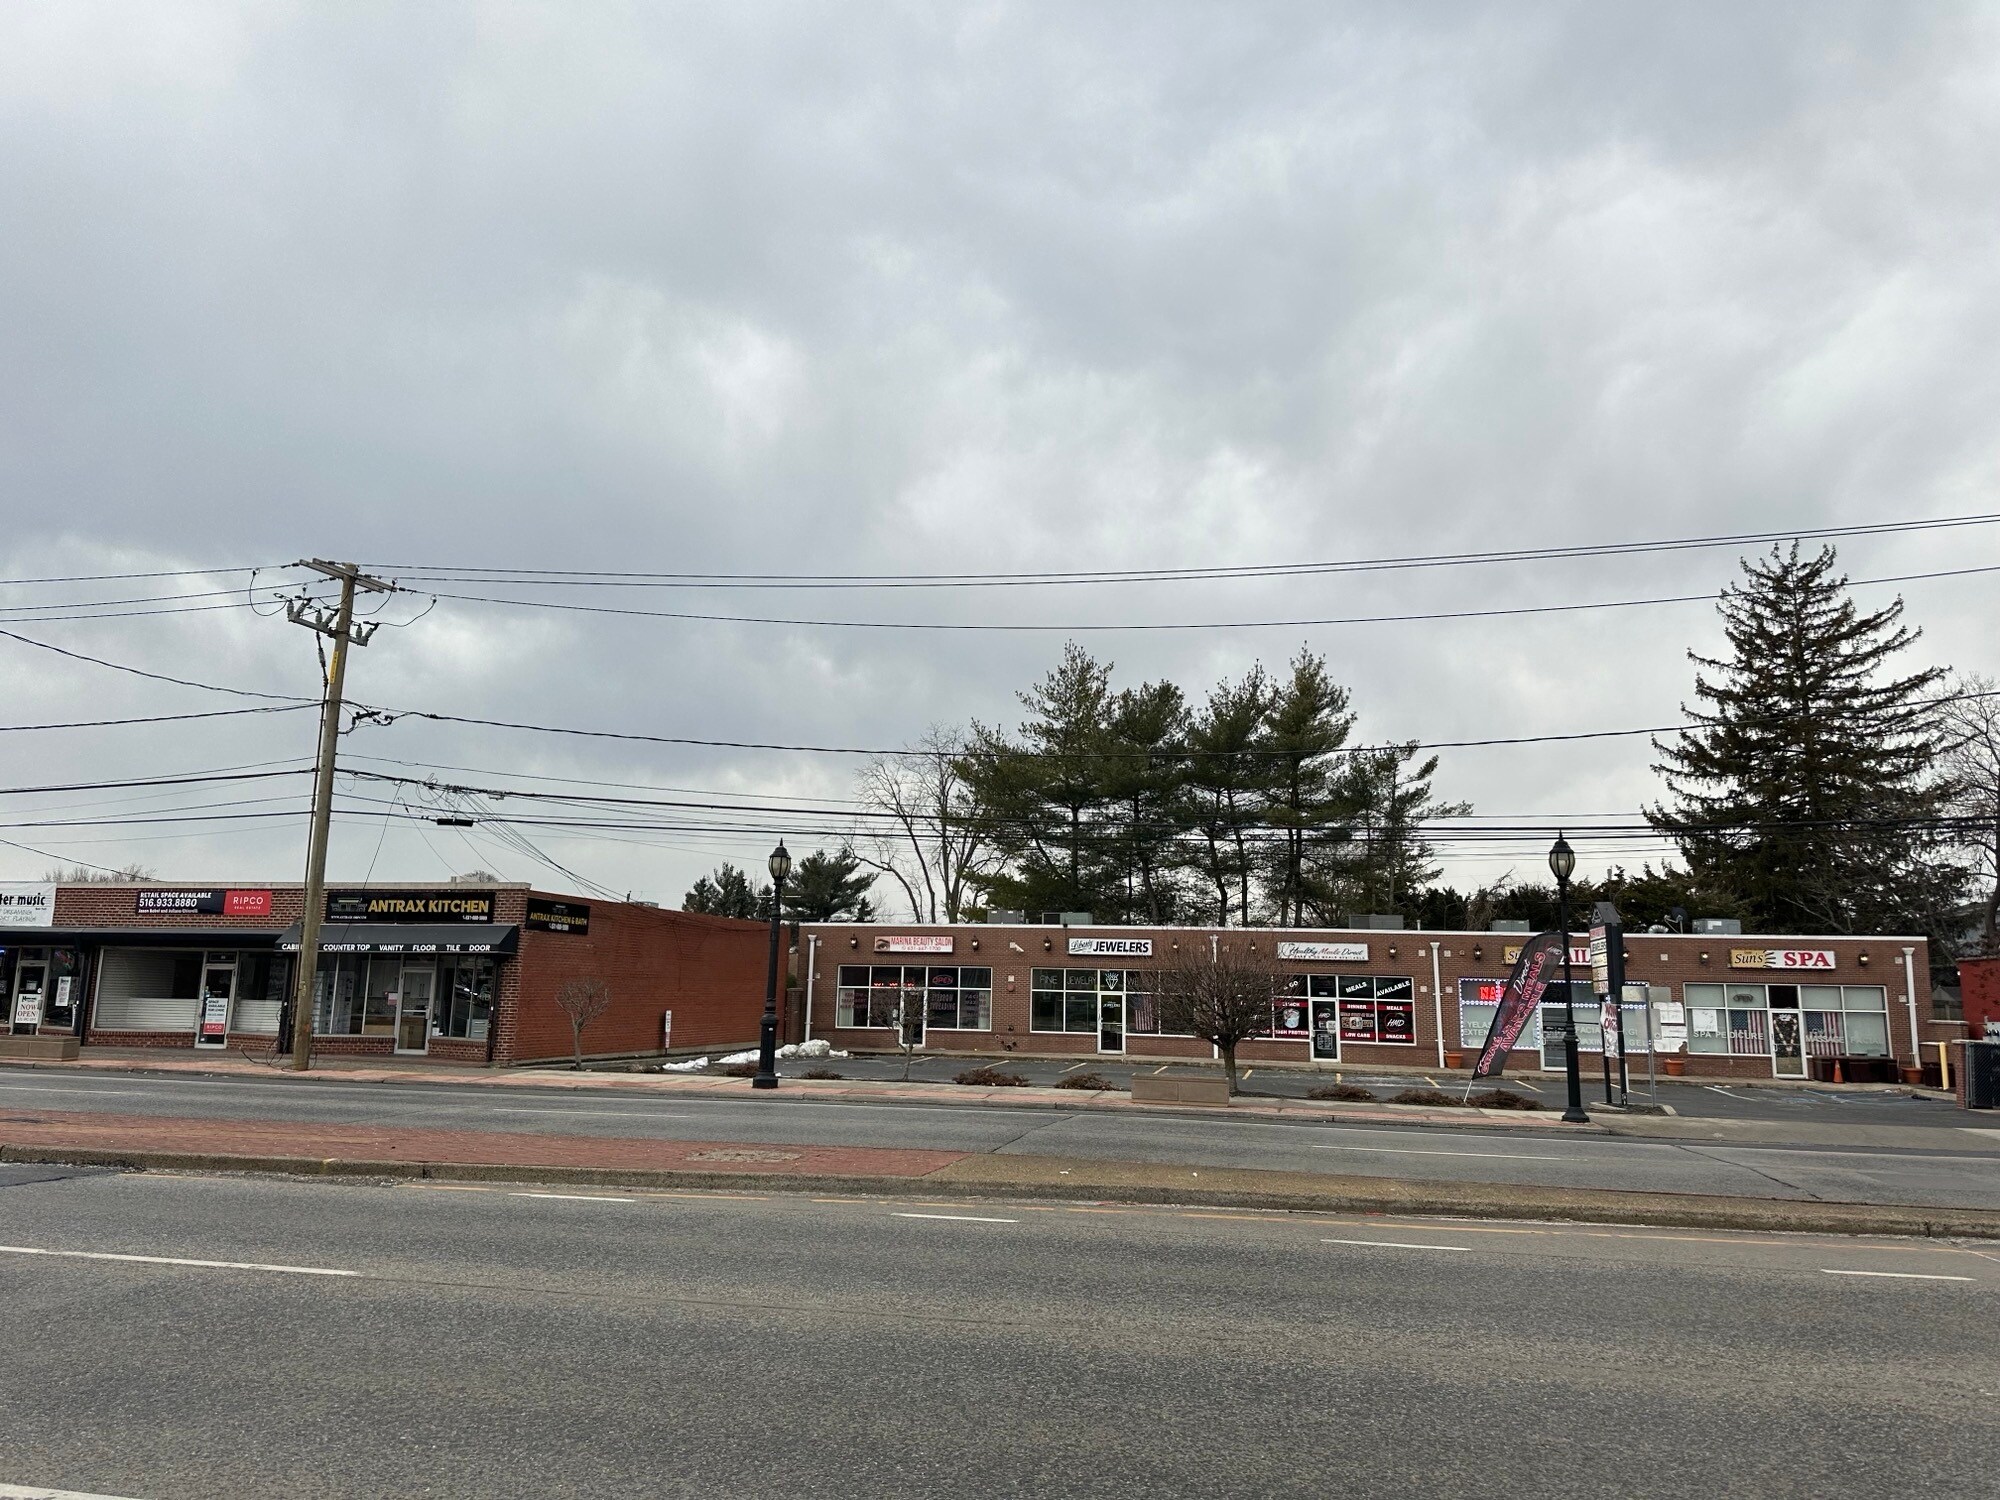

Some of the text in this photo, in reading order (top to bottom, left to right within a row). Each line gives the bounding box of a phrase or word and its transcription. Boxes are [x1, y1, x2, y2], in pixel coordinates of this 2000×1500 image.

[17, 892, 46, 906] music
[139, 898, 198, 908] 516.933.8880
[233, 896, 264, 905] RIPCO
[368, 899, 489, 913] ANTRAX KITCHEN
[530, 911, 550, 922] ANTRAX
[913, 937, 934, 946] BEAUTY
[469, 944, 491, 952] DOOR
[1093, 941, 1149, 953] JEWELERS
[1734, 952, 1832, 967] Sun's SPA
[1040, 975, 1058, 985] FINE
[1067, 975, 1097, 985] JEWELRY
[1522, 951, 1546, 1001] MEALS
[1345, 981, 1367, 993] MEALS
[1376, 980, 1411, 997] AVAILABLE
[1387, 1018, 1405, 1027] HMD
[1715, 1031, 1764, 1041] PEDICURE
[1805, 1035, 1845, 1044] MASSAGE
